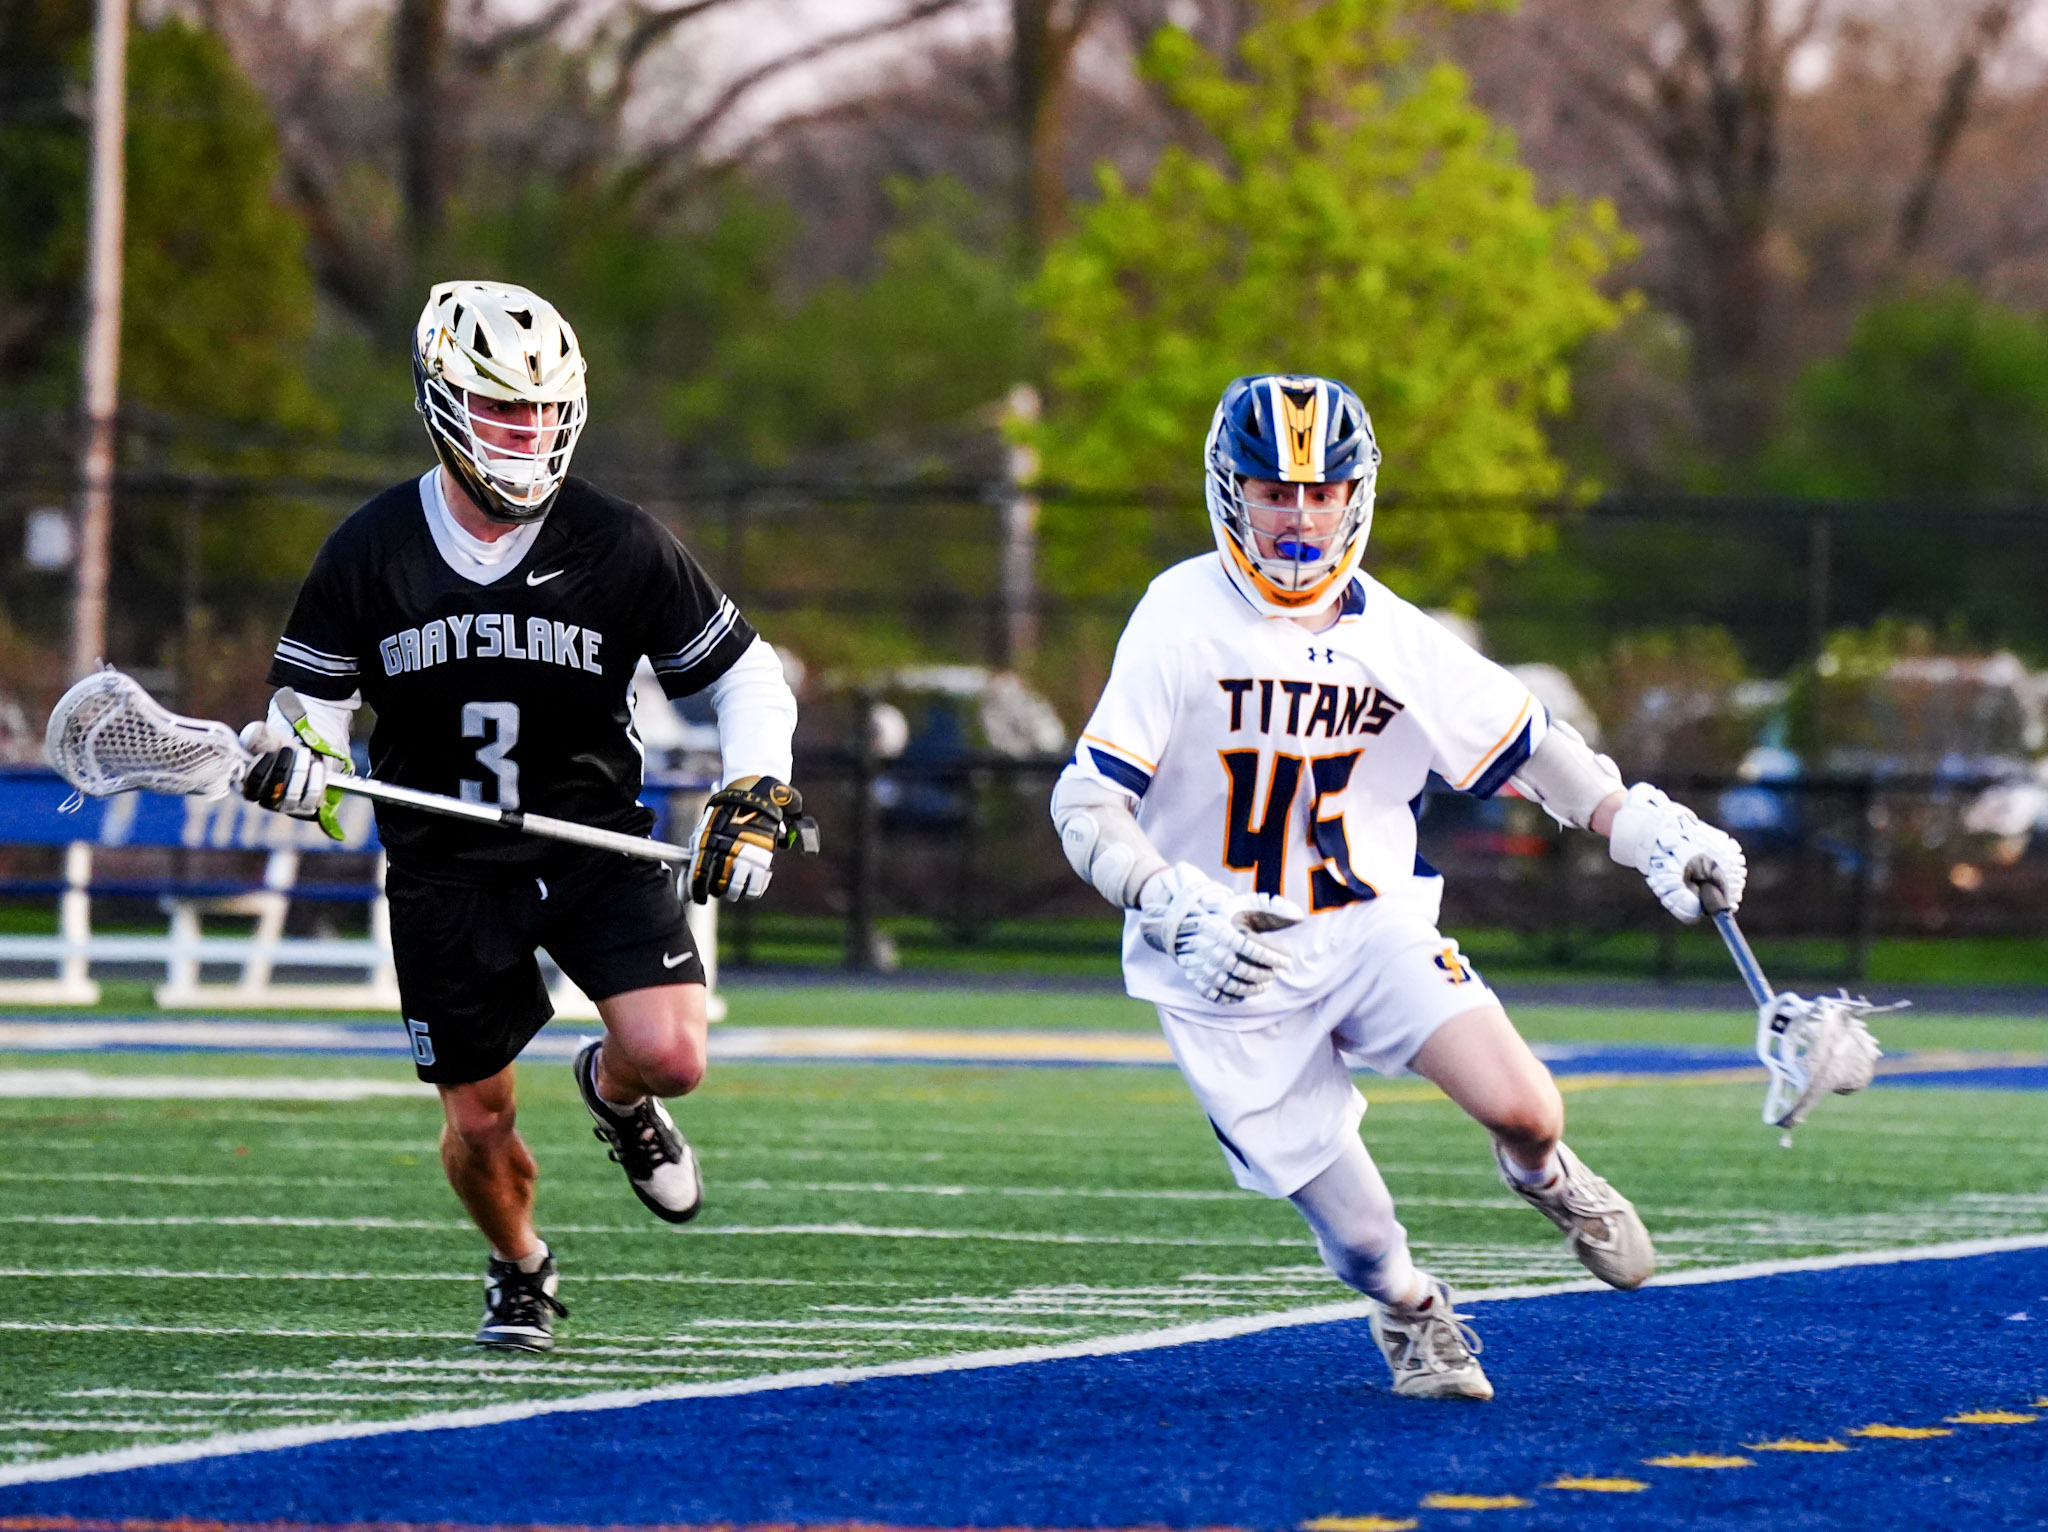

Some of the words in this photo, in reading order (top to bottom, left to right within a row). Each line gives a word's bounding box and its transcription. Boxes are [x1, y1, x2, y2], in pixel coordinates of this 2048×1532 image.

[379, 613, 603, 677] GRAYSLAKE
[1217, 678, 1405, 738] TITANS
[459, 701, 520, 811] 3
[1217, 748, 1381, 915] 45
[408, 1018, 437, 1066] G
